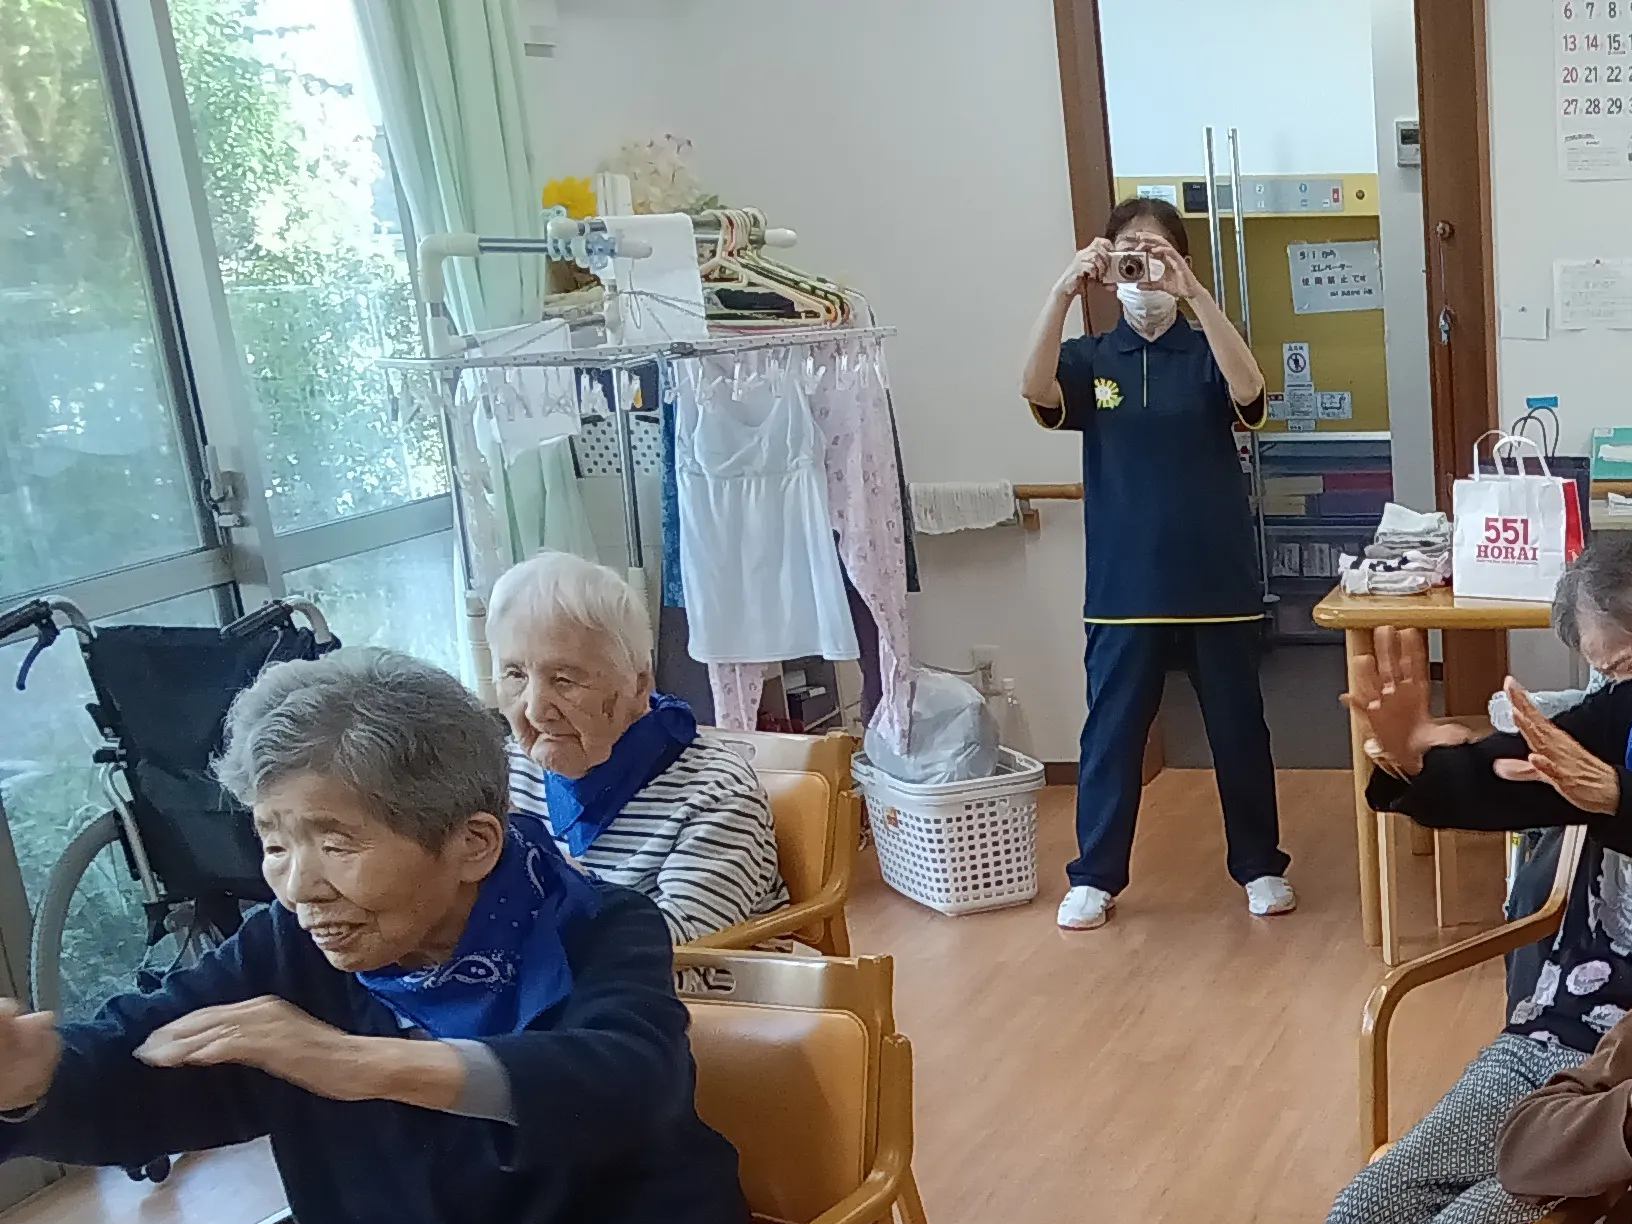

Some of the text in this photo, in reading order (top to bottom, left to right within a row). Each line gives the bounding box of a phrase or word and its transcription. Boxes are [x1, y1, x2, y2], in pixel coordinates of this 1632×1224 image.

[1563, 1, 1573, 19] 6
[1585, 2, 1595, 19] 7
[1608, 1, 1617, 19] 8
[1562, 34, 1577, 51] 13
[1584, 34, 1599, 51] 14
[1607, 33, 1621, 51] 15
[1562, 66, 1578, 83] 20
[1584, 66, 1598, 83] 21
[1606, 65, 1622, 82] 22
[1562, 98, 1579, 115] 27
[1584, 98, 1601, 115] 28
[1606, 98, 1623, 115] 29
[1484, 517, 1529, 545] 551
[1475, 544, 1540, 561] HORAI
